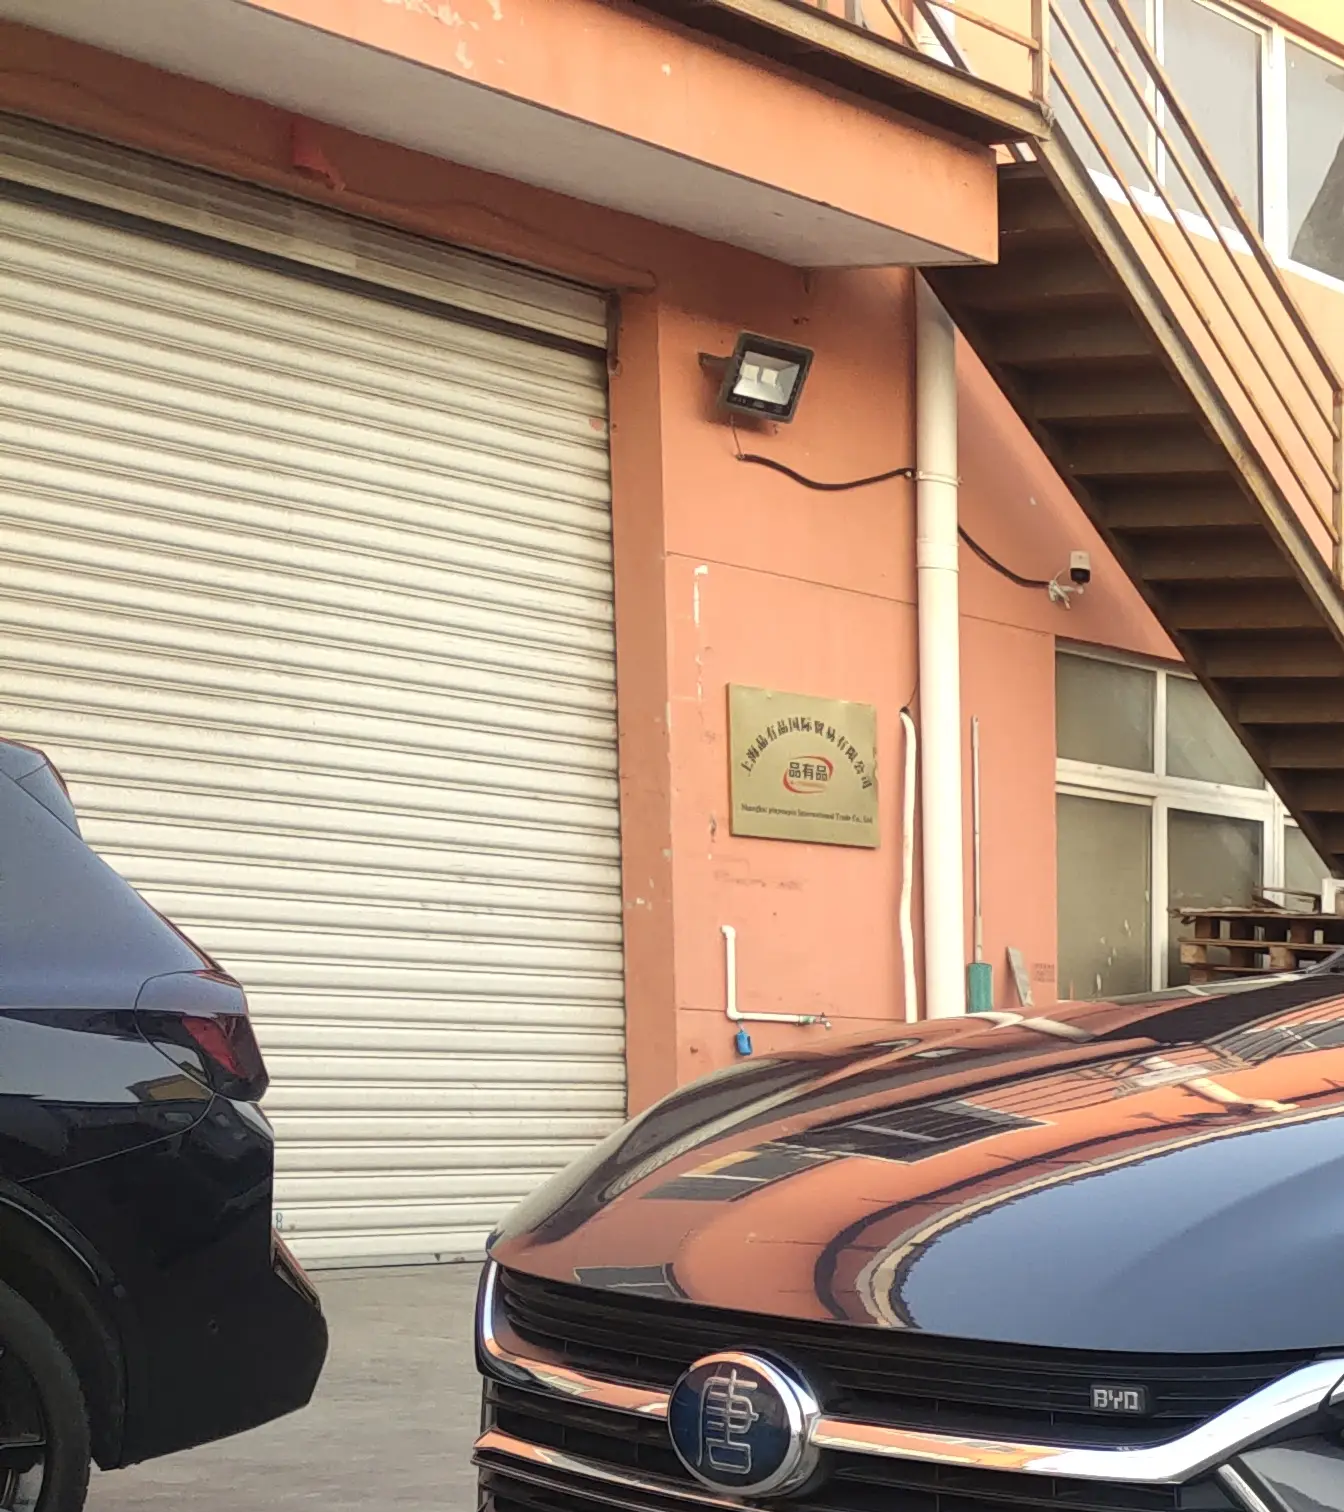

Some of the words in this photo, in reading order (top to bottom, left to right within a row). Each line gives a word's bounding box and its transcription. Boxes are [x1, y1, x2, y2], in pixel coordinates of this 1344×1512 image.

[788, 761, 828, 781] 品有品
[1093, 1389, 1139, 1410] BYD
